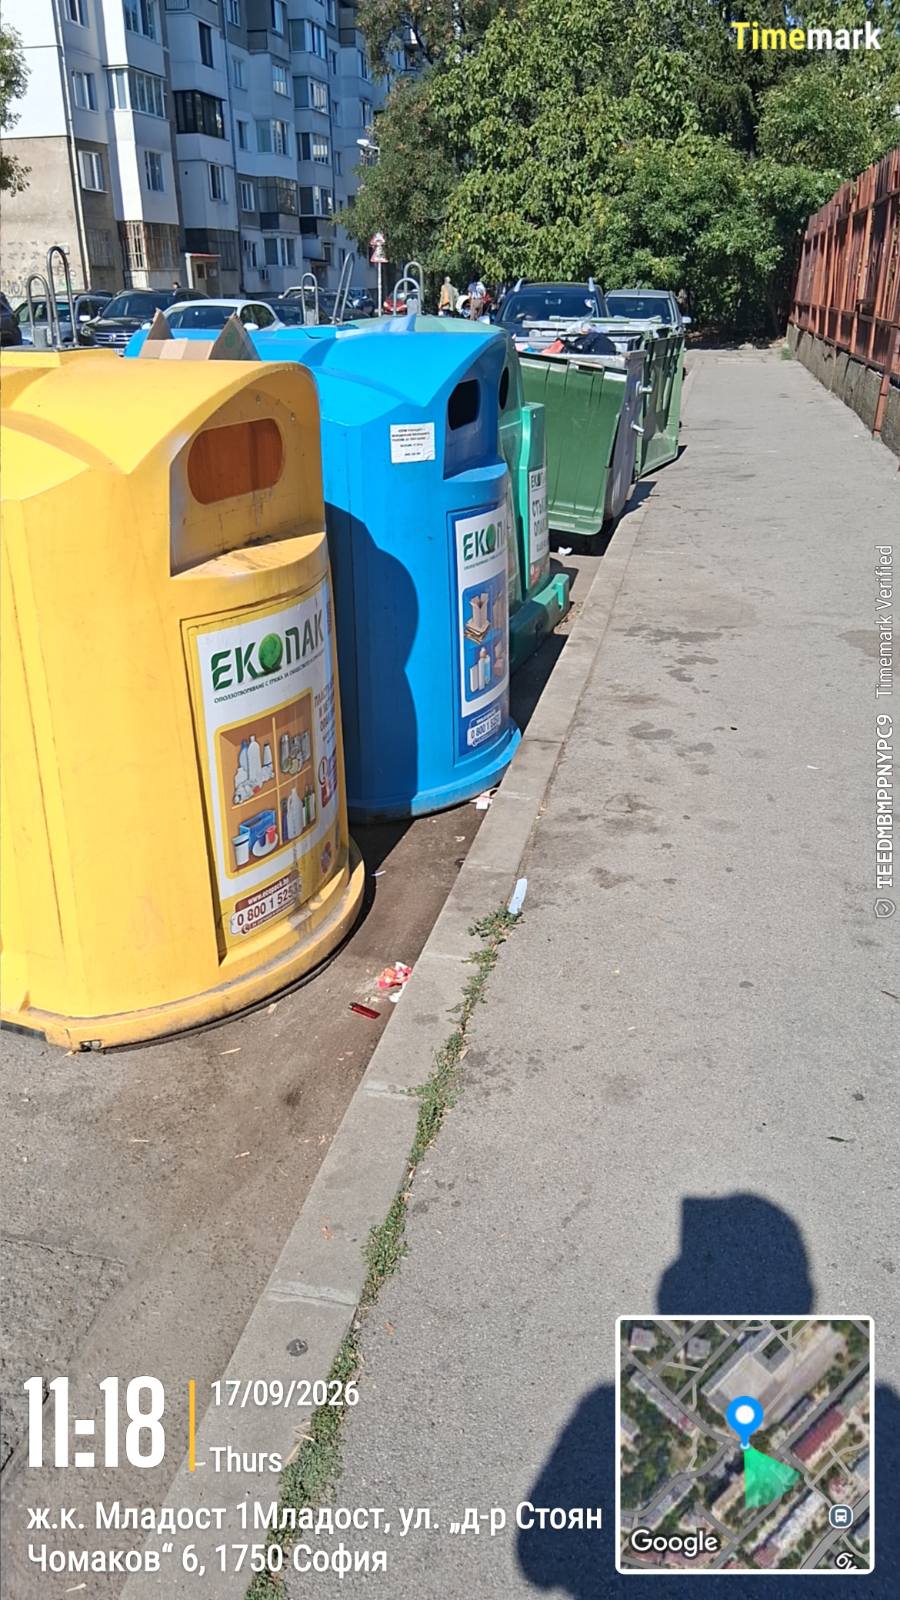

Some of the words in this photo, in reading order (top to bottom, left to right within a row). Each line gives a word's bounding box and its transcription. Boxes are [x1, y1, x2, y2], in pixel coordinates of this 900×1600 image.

[210, 608, 324, 691] ЕКОПАК
[237, 913, 244, 926] 0
[247, 902, 266, 921] 800
